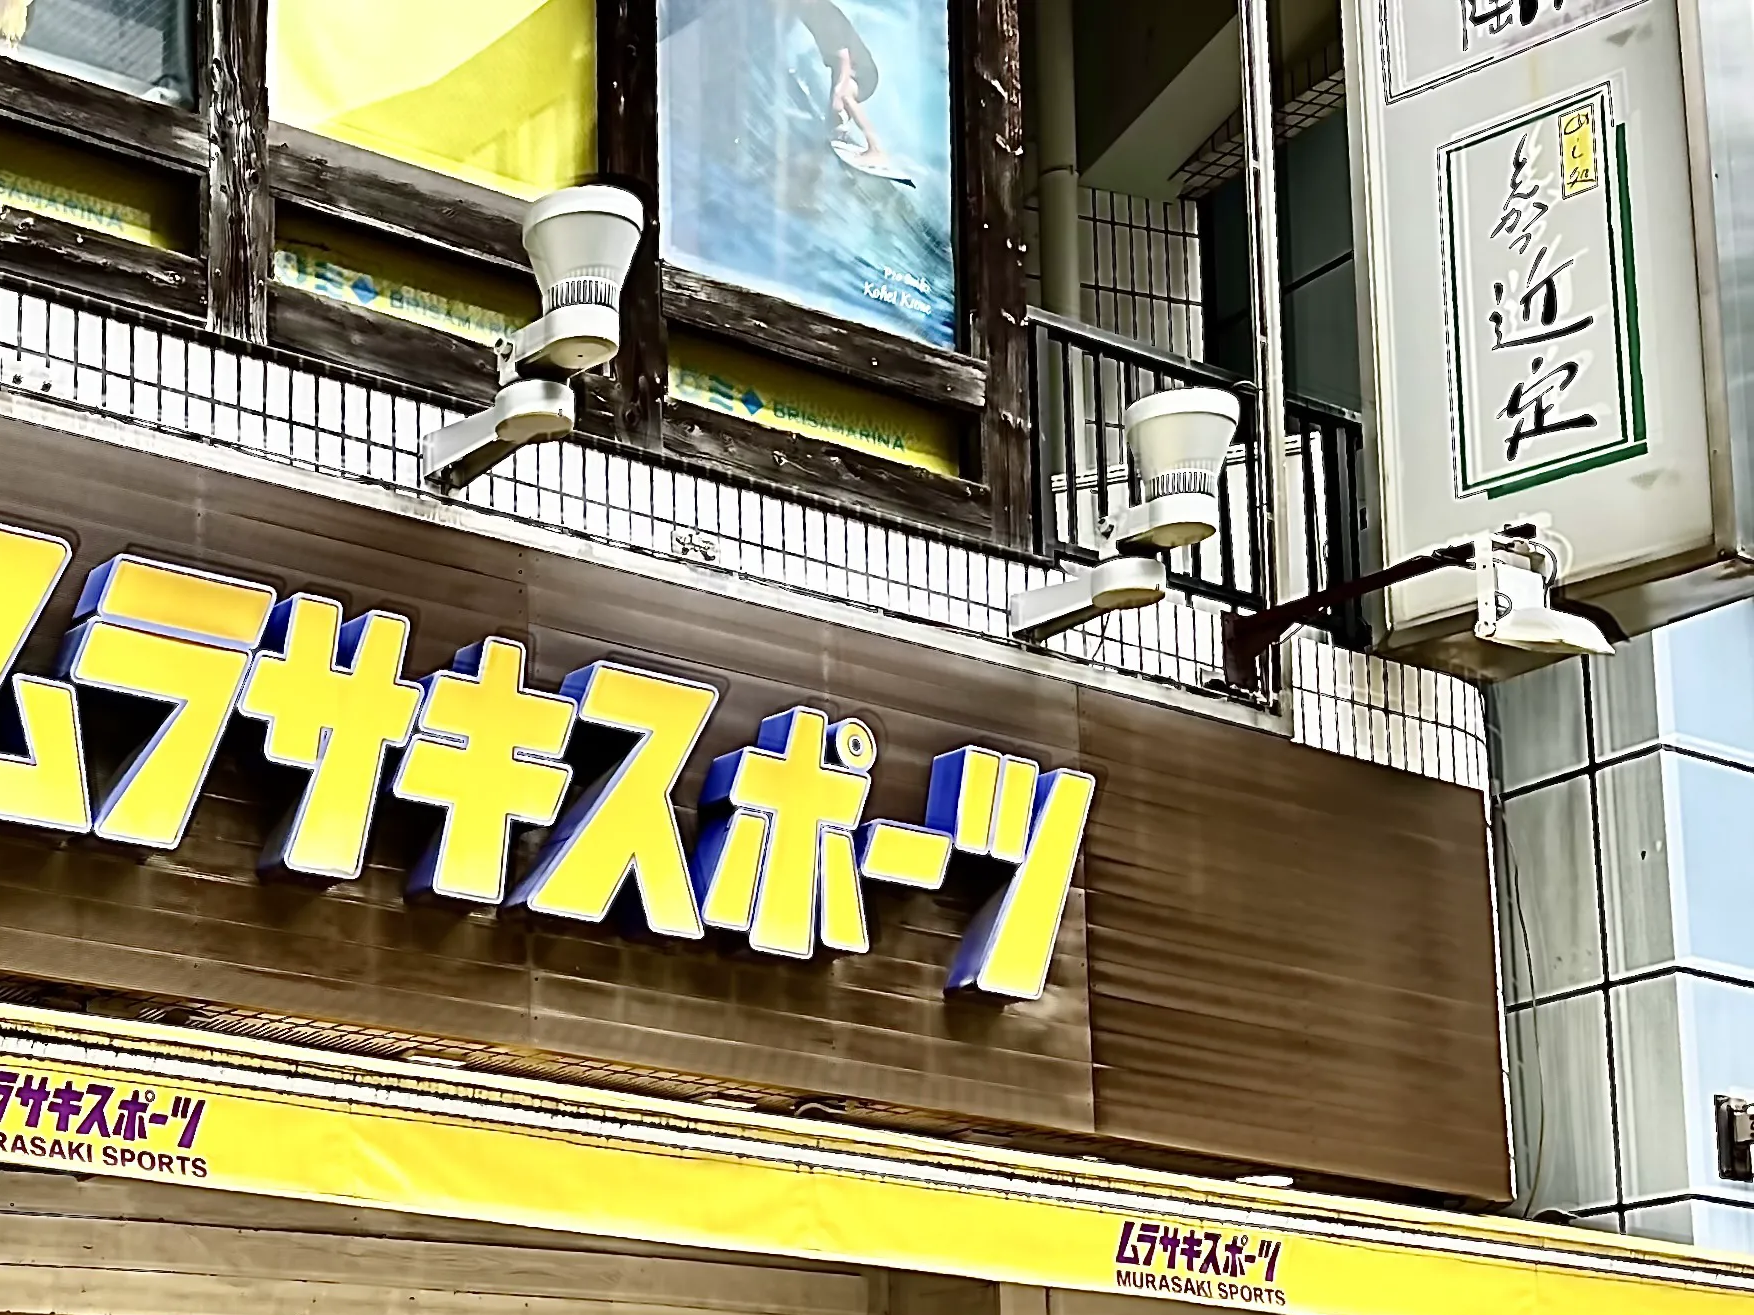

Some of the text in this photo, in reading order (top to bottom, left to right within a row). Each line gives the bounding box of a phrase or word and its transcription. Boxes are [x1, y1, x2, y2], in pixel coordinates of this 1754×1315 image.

[102, 1145, 208, 1178] SPORTS
[1115, 1220, 1283, 1282] ムラサキスポーツ
[1116, 1269, 1287, 1306] MURASAKI SPORTS
